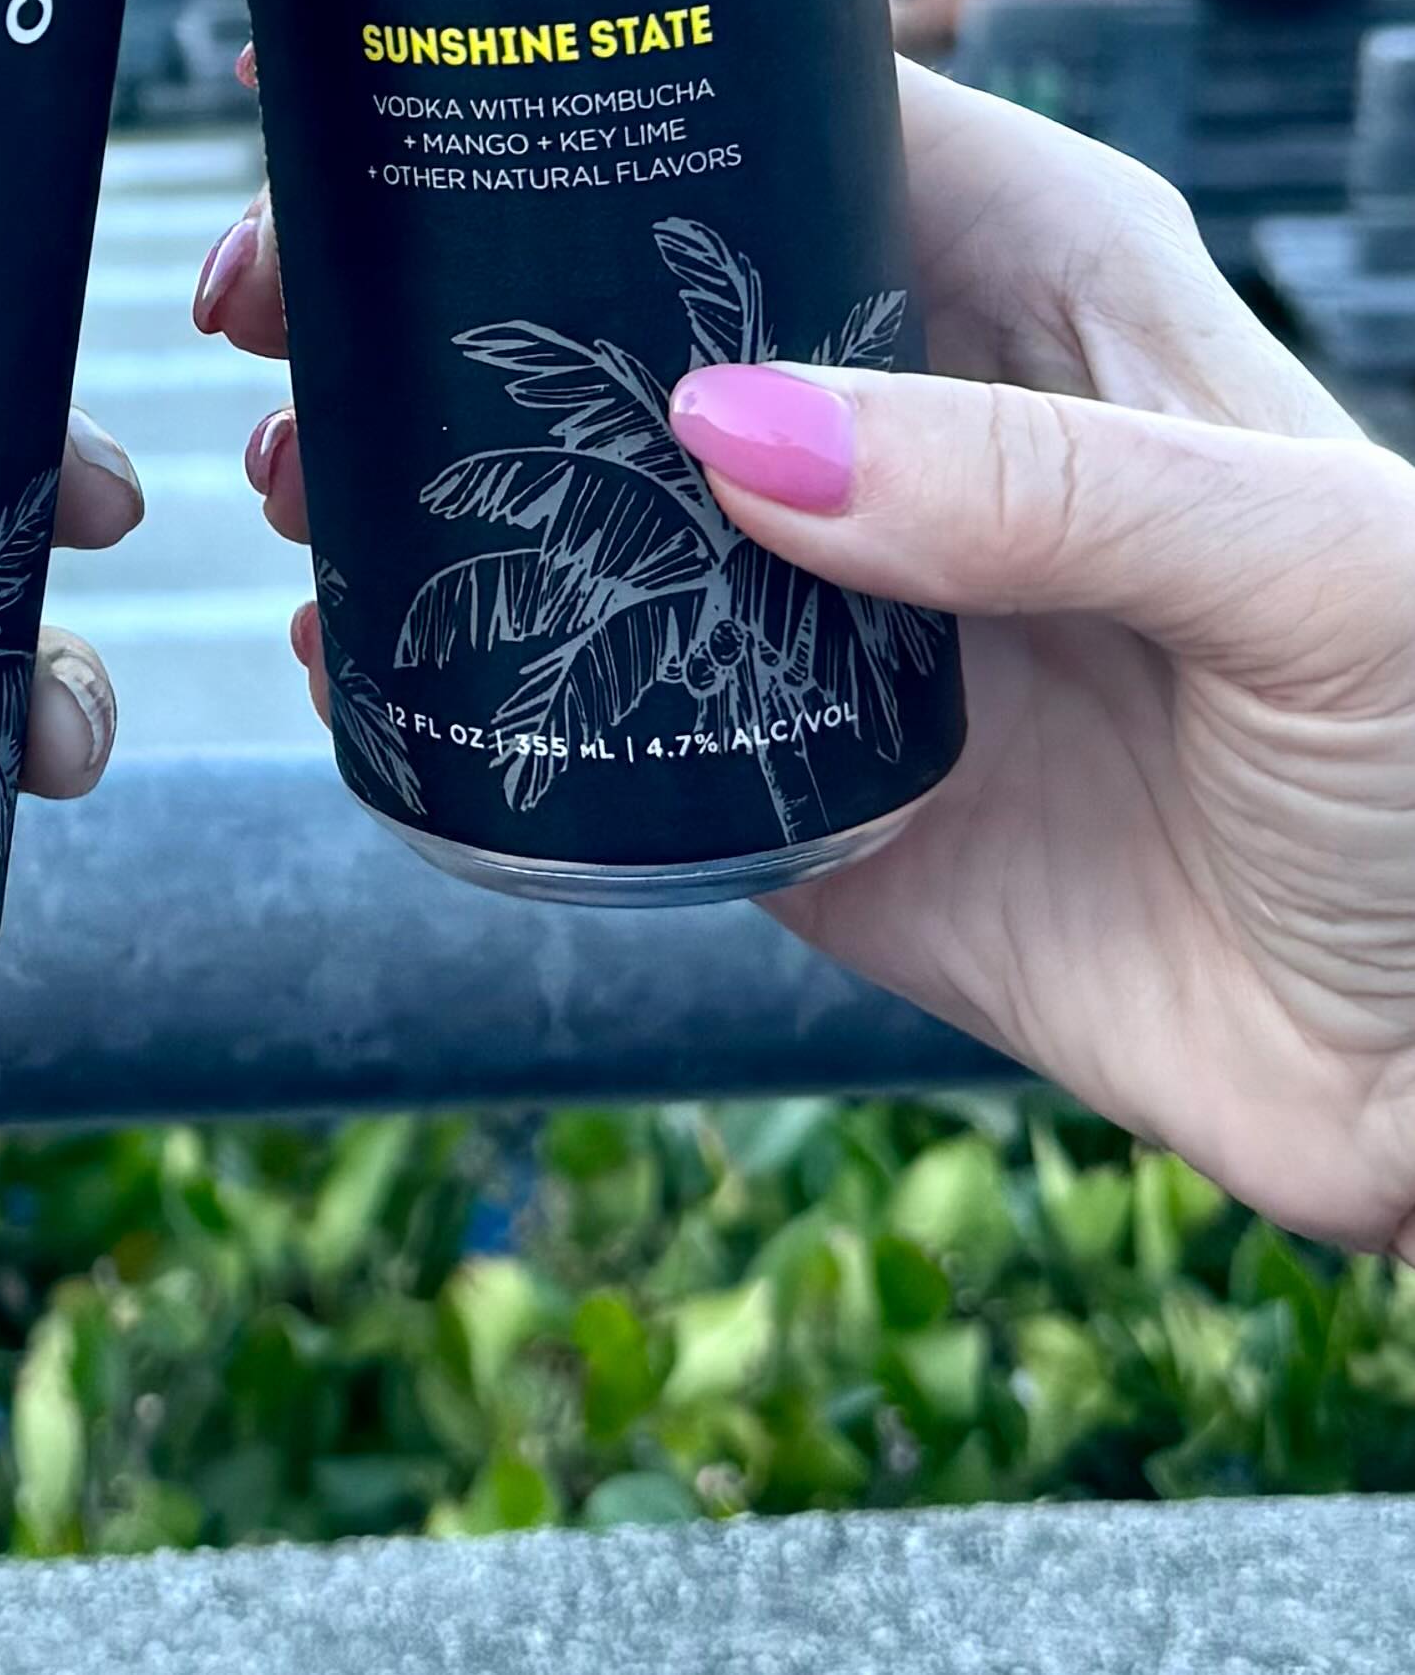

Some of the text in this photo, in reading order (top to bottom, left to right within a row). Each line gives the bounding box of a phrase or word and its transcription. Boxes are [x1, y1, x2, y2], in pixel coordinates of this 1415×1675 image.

[361, 3, 714, 67] SUNSHINE STATE
[371, 77, 717, 122] VODKA WITH KOMBUCHA
[422, 132, 530, 157] MANGO
[558, 126, 618, 153] KEY
[623, 116, 688, 148] LIME
[382, 163, 467, 191] OTHER
[471, 160, 611, 191] NATURAL
[615, 142, 743, 185] FLAVORS
[386, 701, 407, 729] 12
[413, 712, 442, 740] FL
[449, 723, 486, 750] OZ
[513, 733, 569, 759] 355
[646, 731, 719, 759] 4.7%
[730, 702, 858, 751] ALC/VOL
